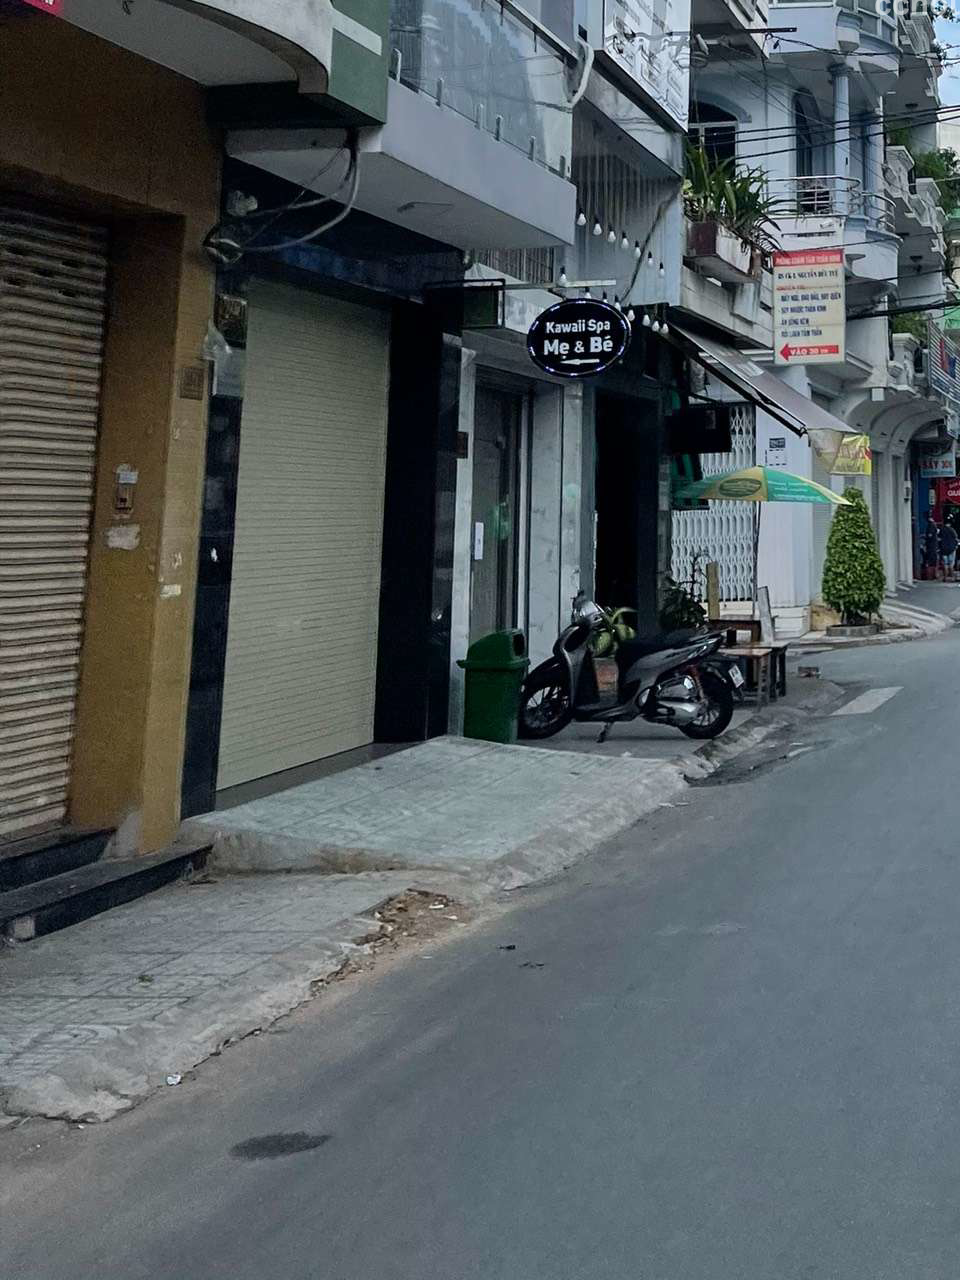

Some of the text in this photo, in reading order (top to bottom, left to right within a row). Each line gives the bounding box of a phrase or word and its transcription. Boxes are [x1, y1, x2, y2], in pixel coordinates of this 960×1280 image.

[545, 319, 611, 334] Kawaii Spa
[543, 335, 613, 359] Mẹ & Bé
